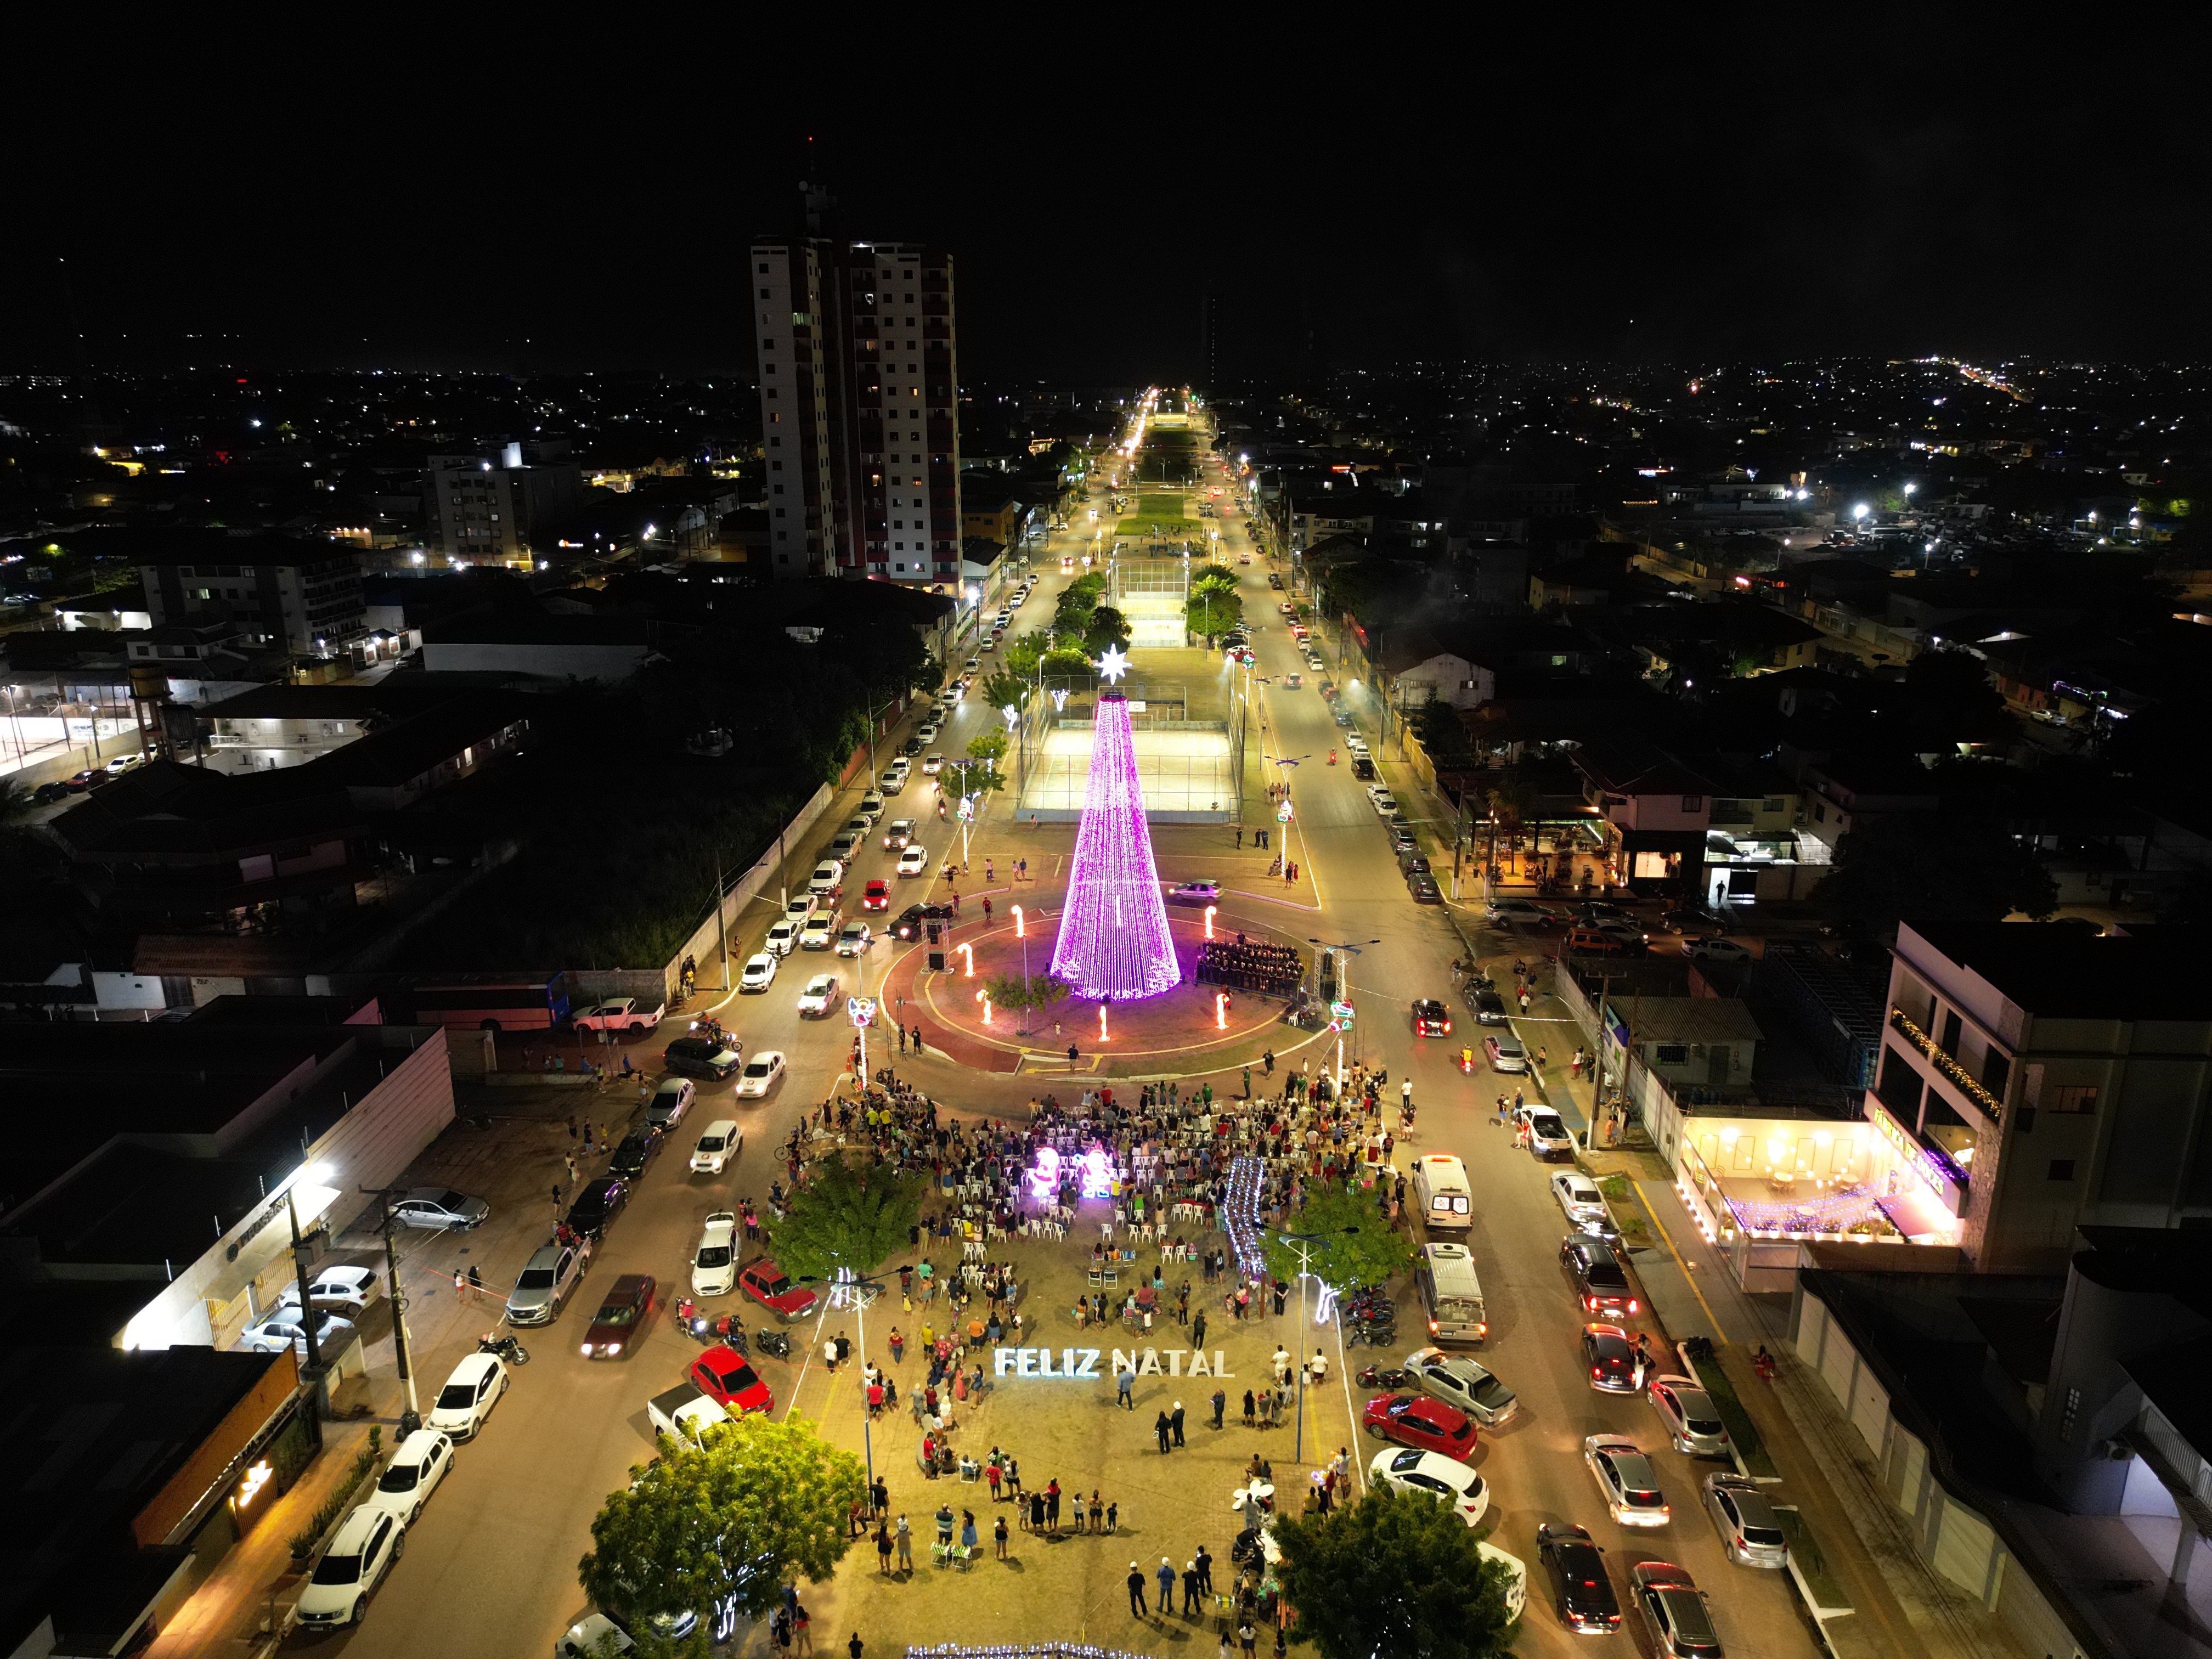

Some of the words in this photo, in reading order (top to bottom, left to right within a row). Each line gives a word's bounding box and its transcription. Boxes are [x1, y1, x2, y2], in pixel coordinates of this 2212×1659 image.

[1916, 1155, 1944, 1195] DOCES
[994, 1347, 1101, 1378] FELIZ
[1111, 1347, 1235, 1378] NATAL
